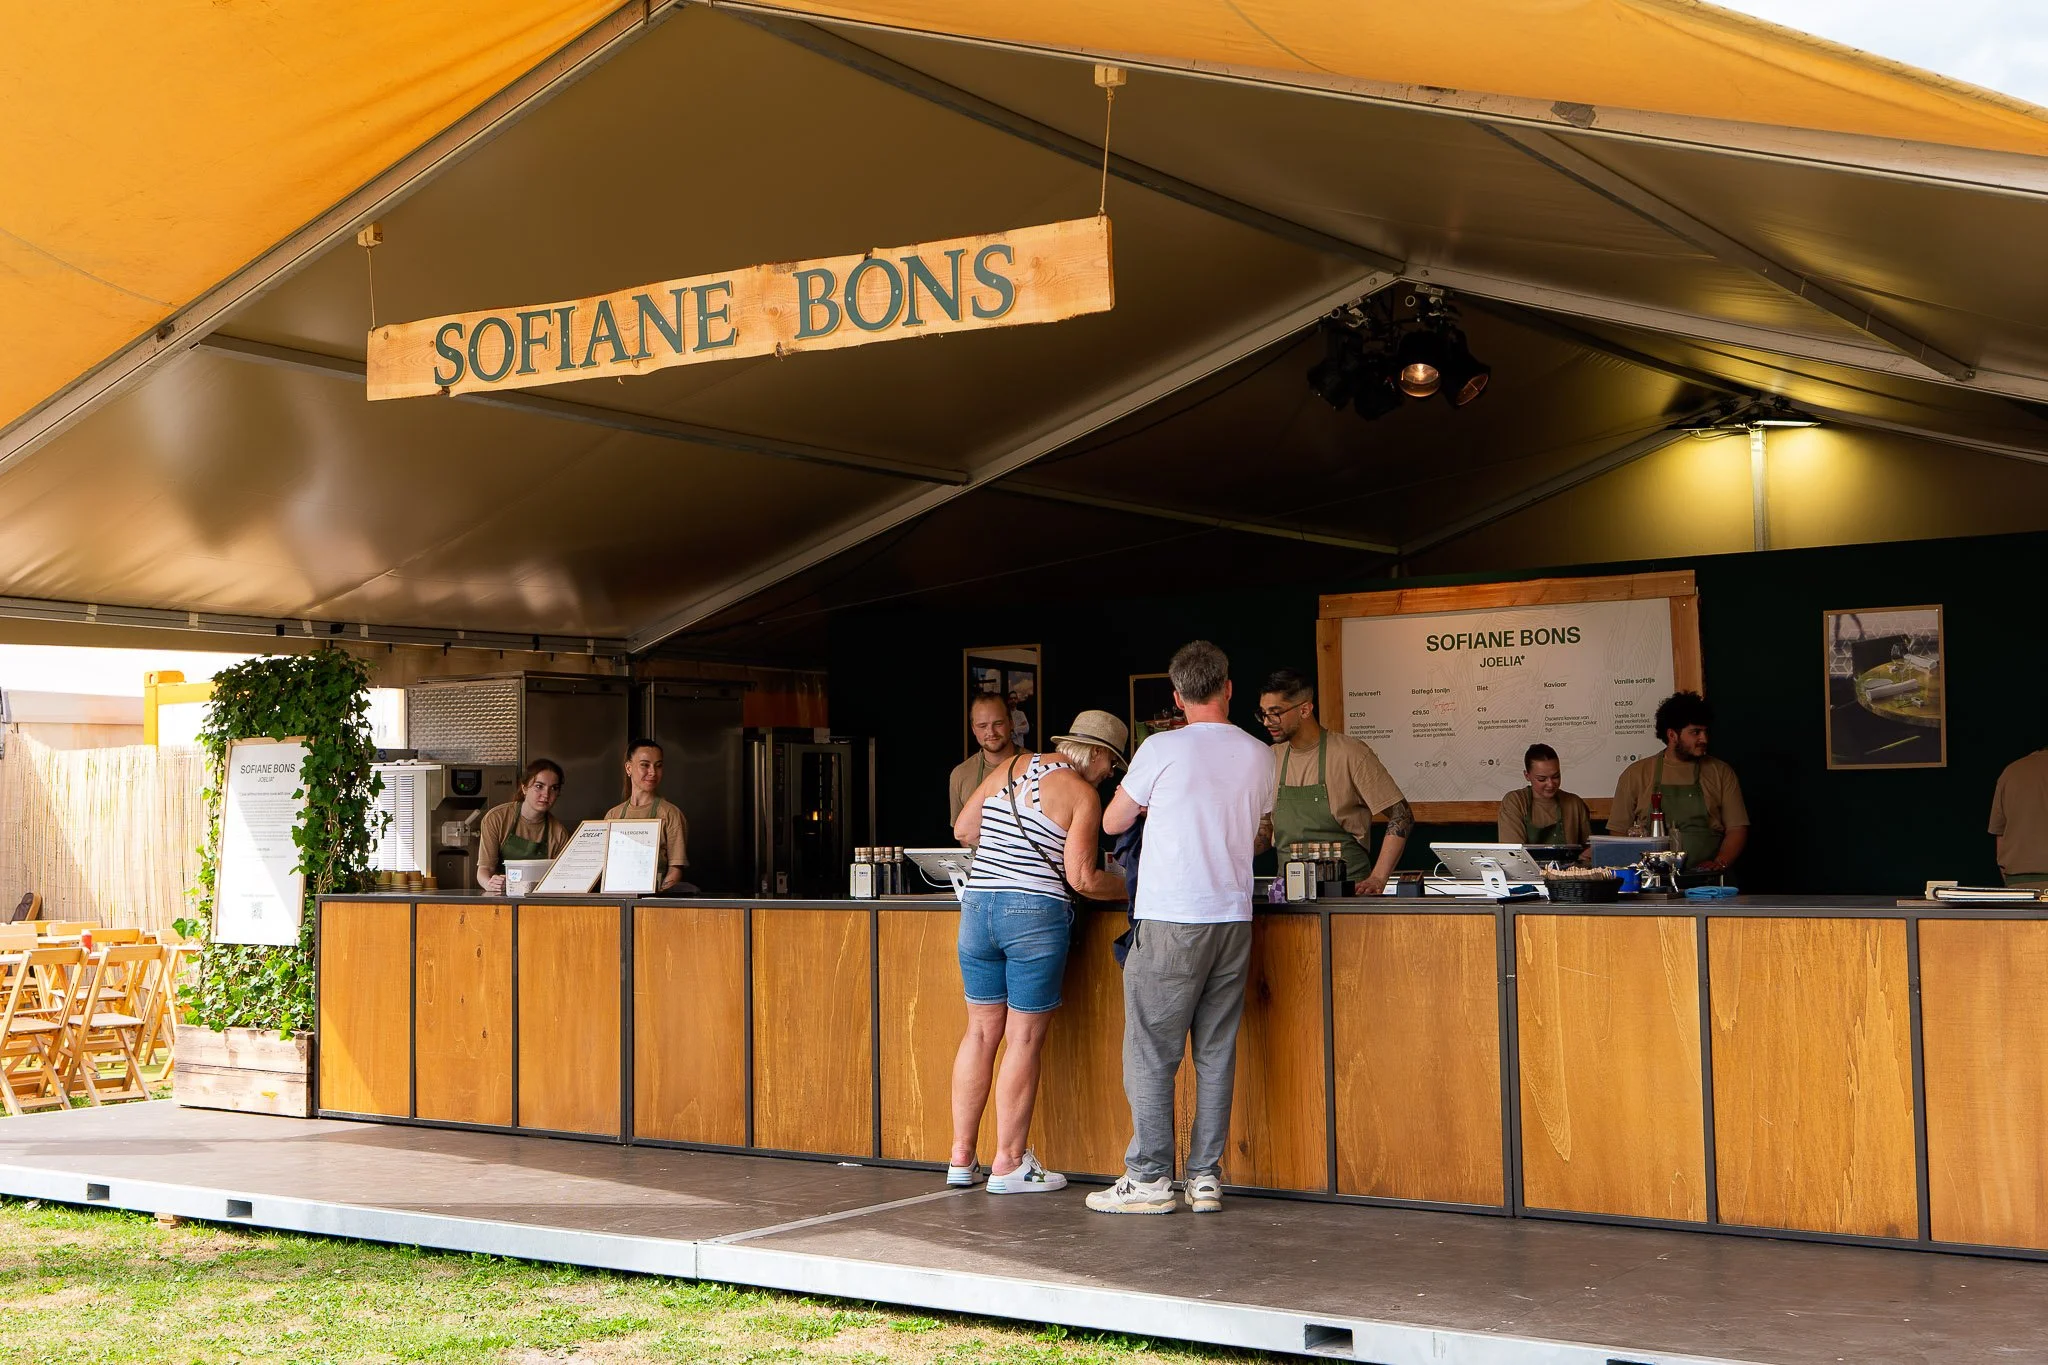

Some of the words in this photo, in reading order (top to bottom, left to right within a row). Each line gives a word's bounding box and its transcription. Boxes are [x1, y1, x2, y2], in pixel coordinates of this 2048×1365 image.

[434, 280, 738, 387] SOFIANE
[794, 243, 1017, 341] BONS
[1426, 630, 1515, 652] SOFIANE
[1520, 626, 1581, 646] BONS
[240, 764, 272, 775] SOFIANE
[273, 763, 296, 773] BONS
